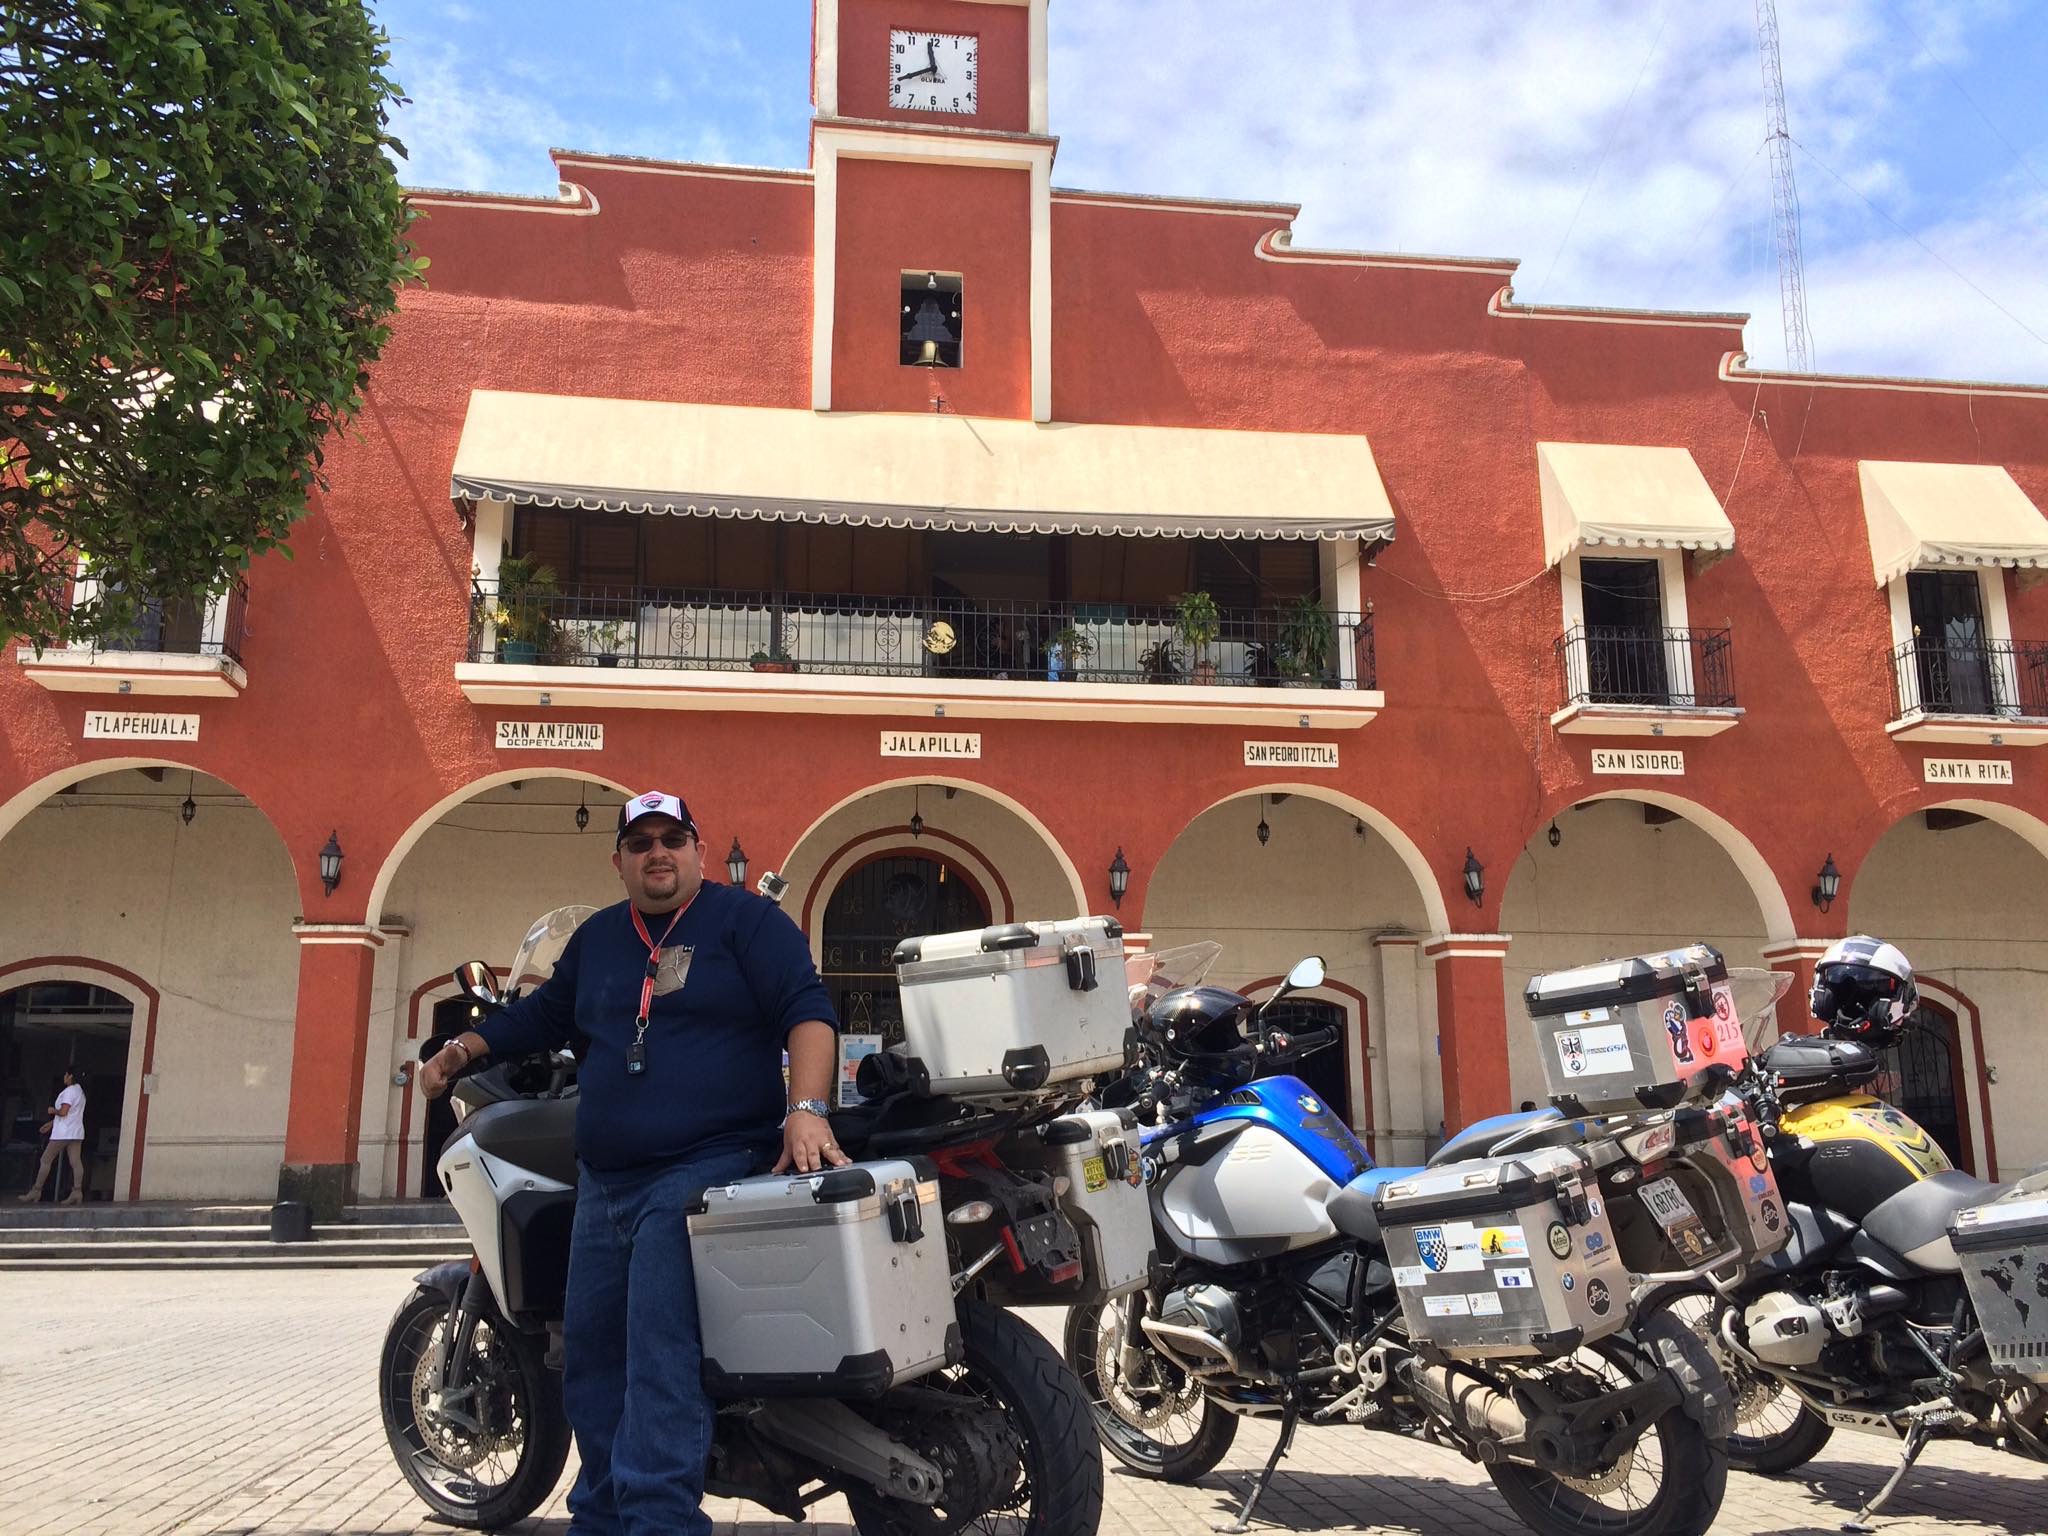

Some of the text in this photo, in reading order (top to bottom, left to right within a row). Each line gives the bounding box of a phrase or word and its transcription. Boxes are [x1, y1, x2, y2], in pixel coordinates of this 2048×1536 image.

[907, 36, 916, 46] 11
[954, 40, 958, 49] 1
[896, 44, 905, 54] 10
[966, 52, 973, 62] 2
[895, 64, 901, 73] 9
[966, 71, 972, 80] 3
[894, 84, 901, 94] 8
[908, 93, 915, 104] 7
[930, 96, 937, 106] 6
[965, 92, 972, 102] 4
[953, 98, 959, 108] 5
[501, 723, 598, 740] SAN ANTONIO
[1248, 745, 1267, 761] SAN
[1269, 746, 1299, 762] PEDRO
[1597, 753, 1626, 769] SAN
[1930, 763, 1971, 778] SANTA
[1717, 1022, 1739, 1042] 215
[1416, 1229, 1441, 1241] BMW
[1831, 1412, 1857, 1424] GS
